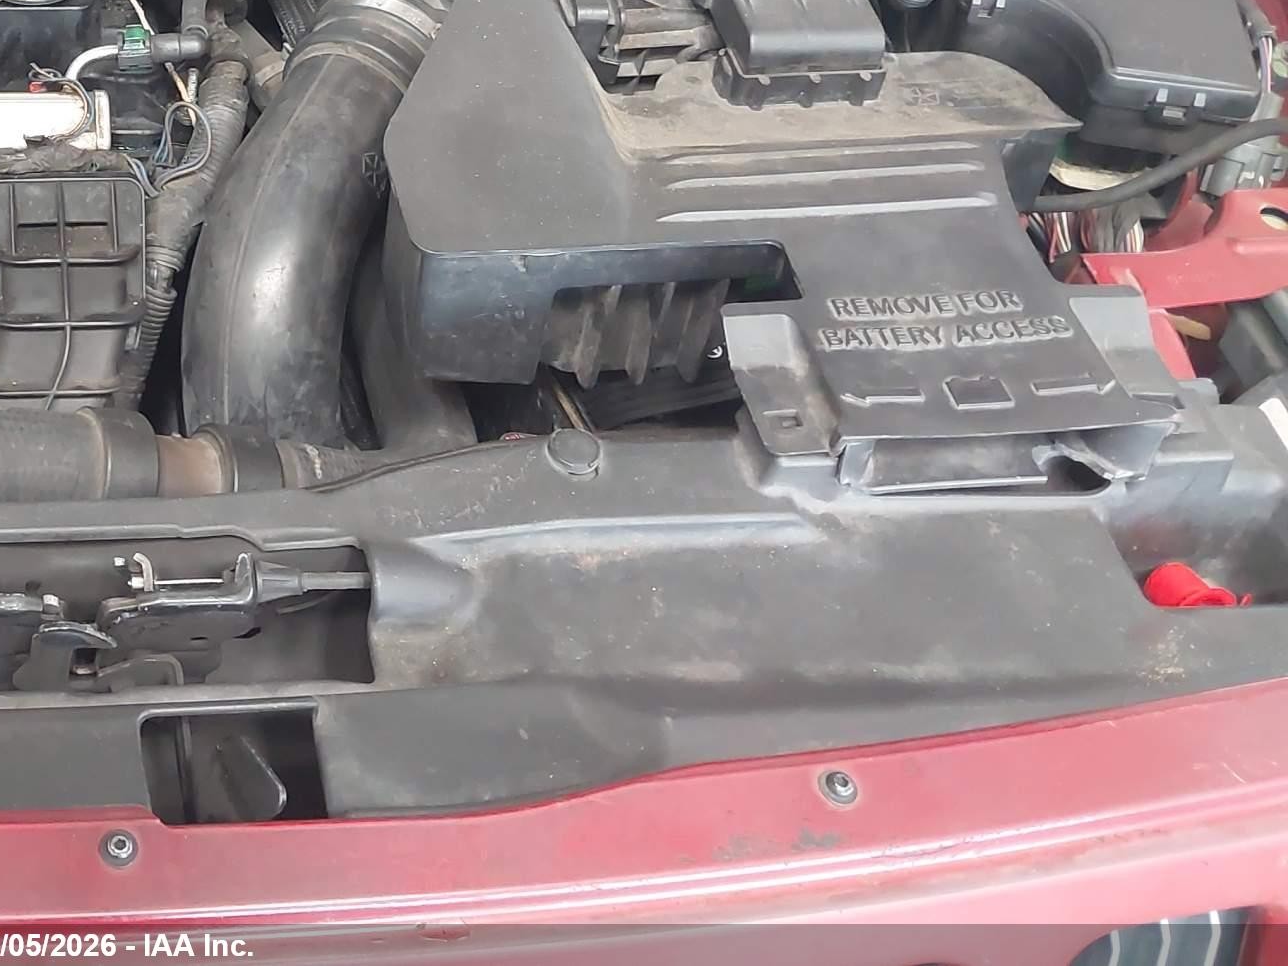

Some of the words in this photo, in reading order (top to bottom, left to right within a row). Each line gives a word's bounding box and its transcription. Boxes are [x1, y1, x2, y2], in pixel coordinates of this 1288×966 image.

[830, 291, 954, 321] REMOVE
[955, 288, 1023, 315] FOR
[819, 321, 945, 350] BATTERY
[954, 315, 1072, 344] ACCESS
